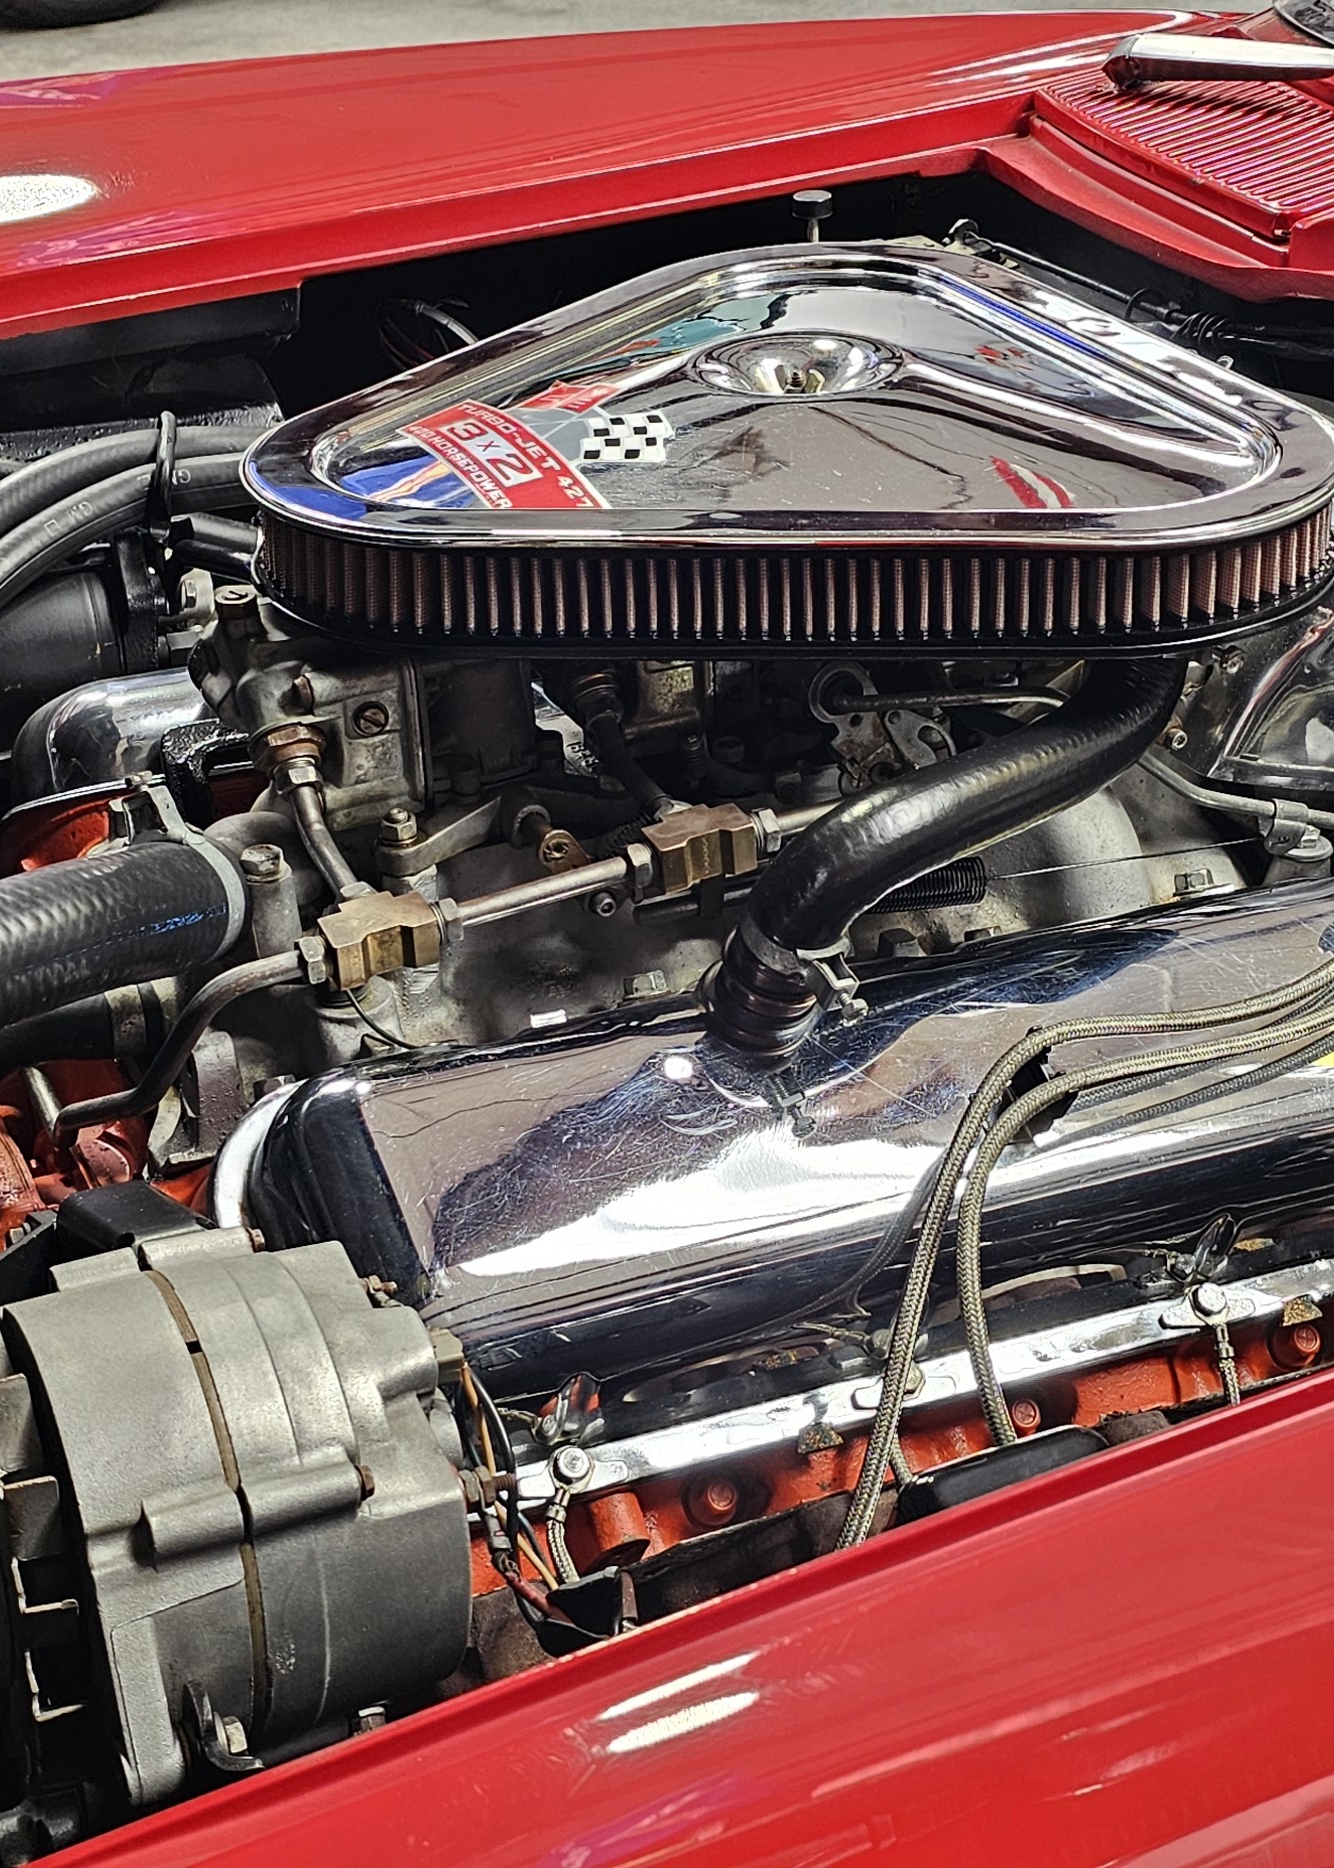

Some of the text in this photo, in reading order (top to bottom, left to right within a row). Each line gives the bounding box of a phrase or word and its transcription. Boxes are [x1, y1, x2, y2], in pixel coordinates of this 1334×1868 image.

[427, 435, 514, 509] HORSEPOWER
[458, 404, 595, 508] TURBO-JET 427
